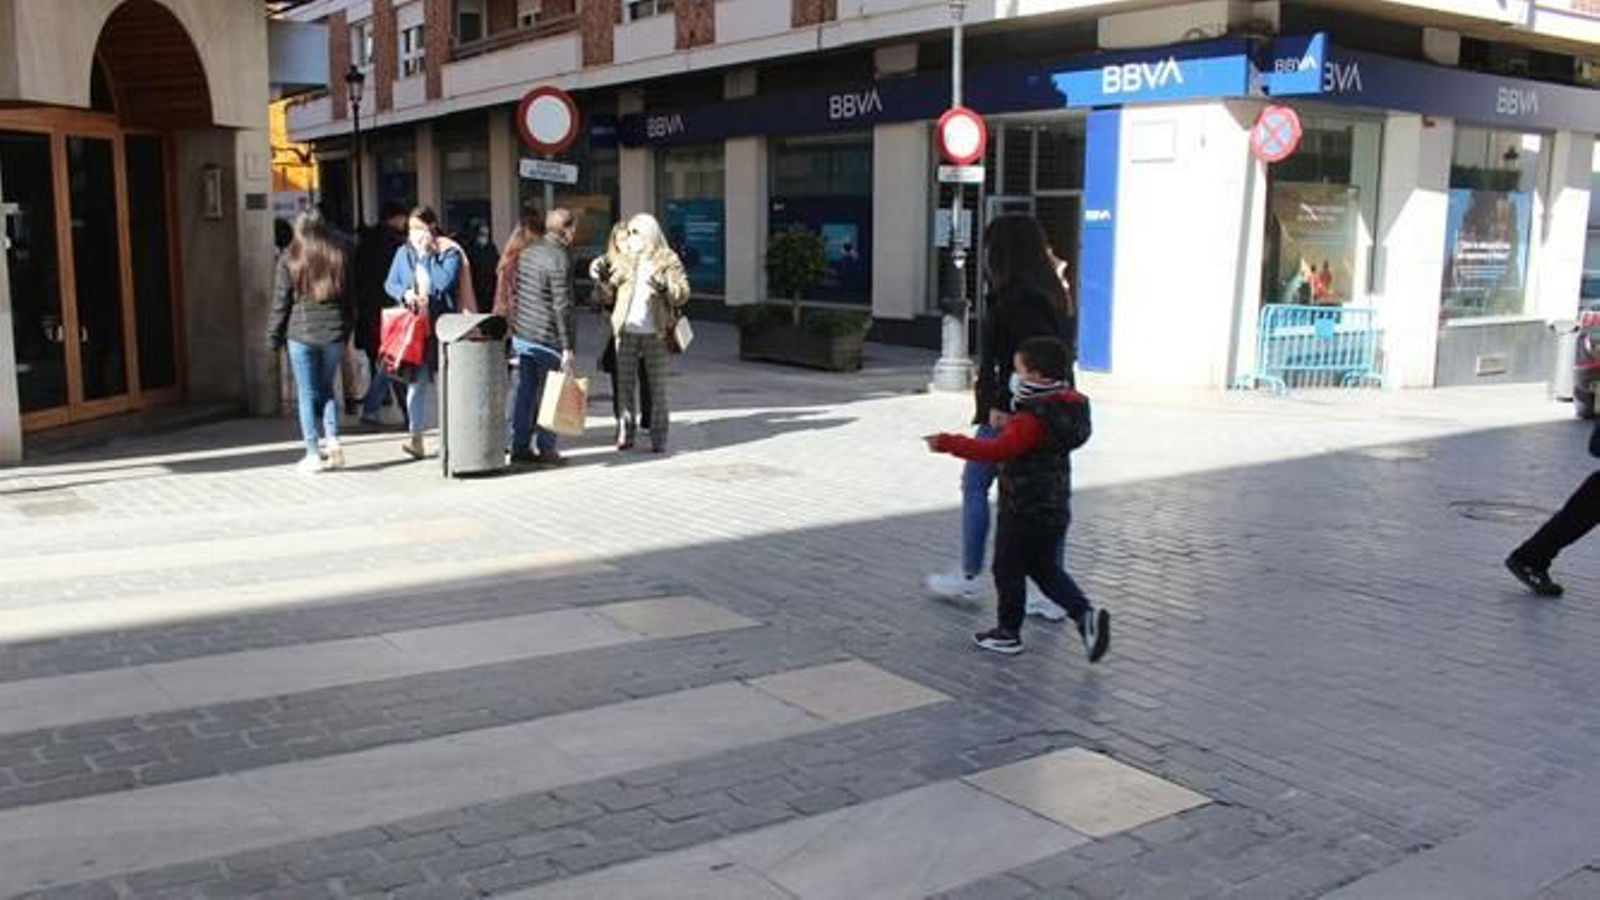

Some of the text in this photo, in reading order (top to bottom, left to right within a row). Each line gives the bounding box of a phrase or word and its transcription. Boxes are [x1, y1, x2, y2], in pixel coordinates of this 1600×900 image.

[1102, 56, 1184, 94] BBVA
[1274, 55, 1317, 71] BBVA
[828, 89, 882, 119] BBVA
[1496, 86, 1538, 115] BBVA
[646, 114, 684, 138] BBVA
